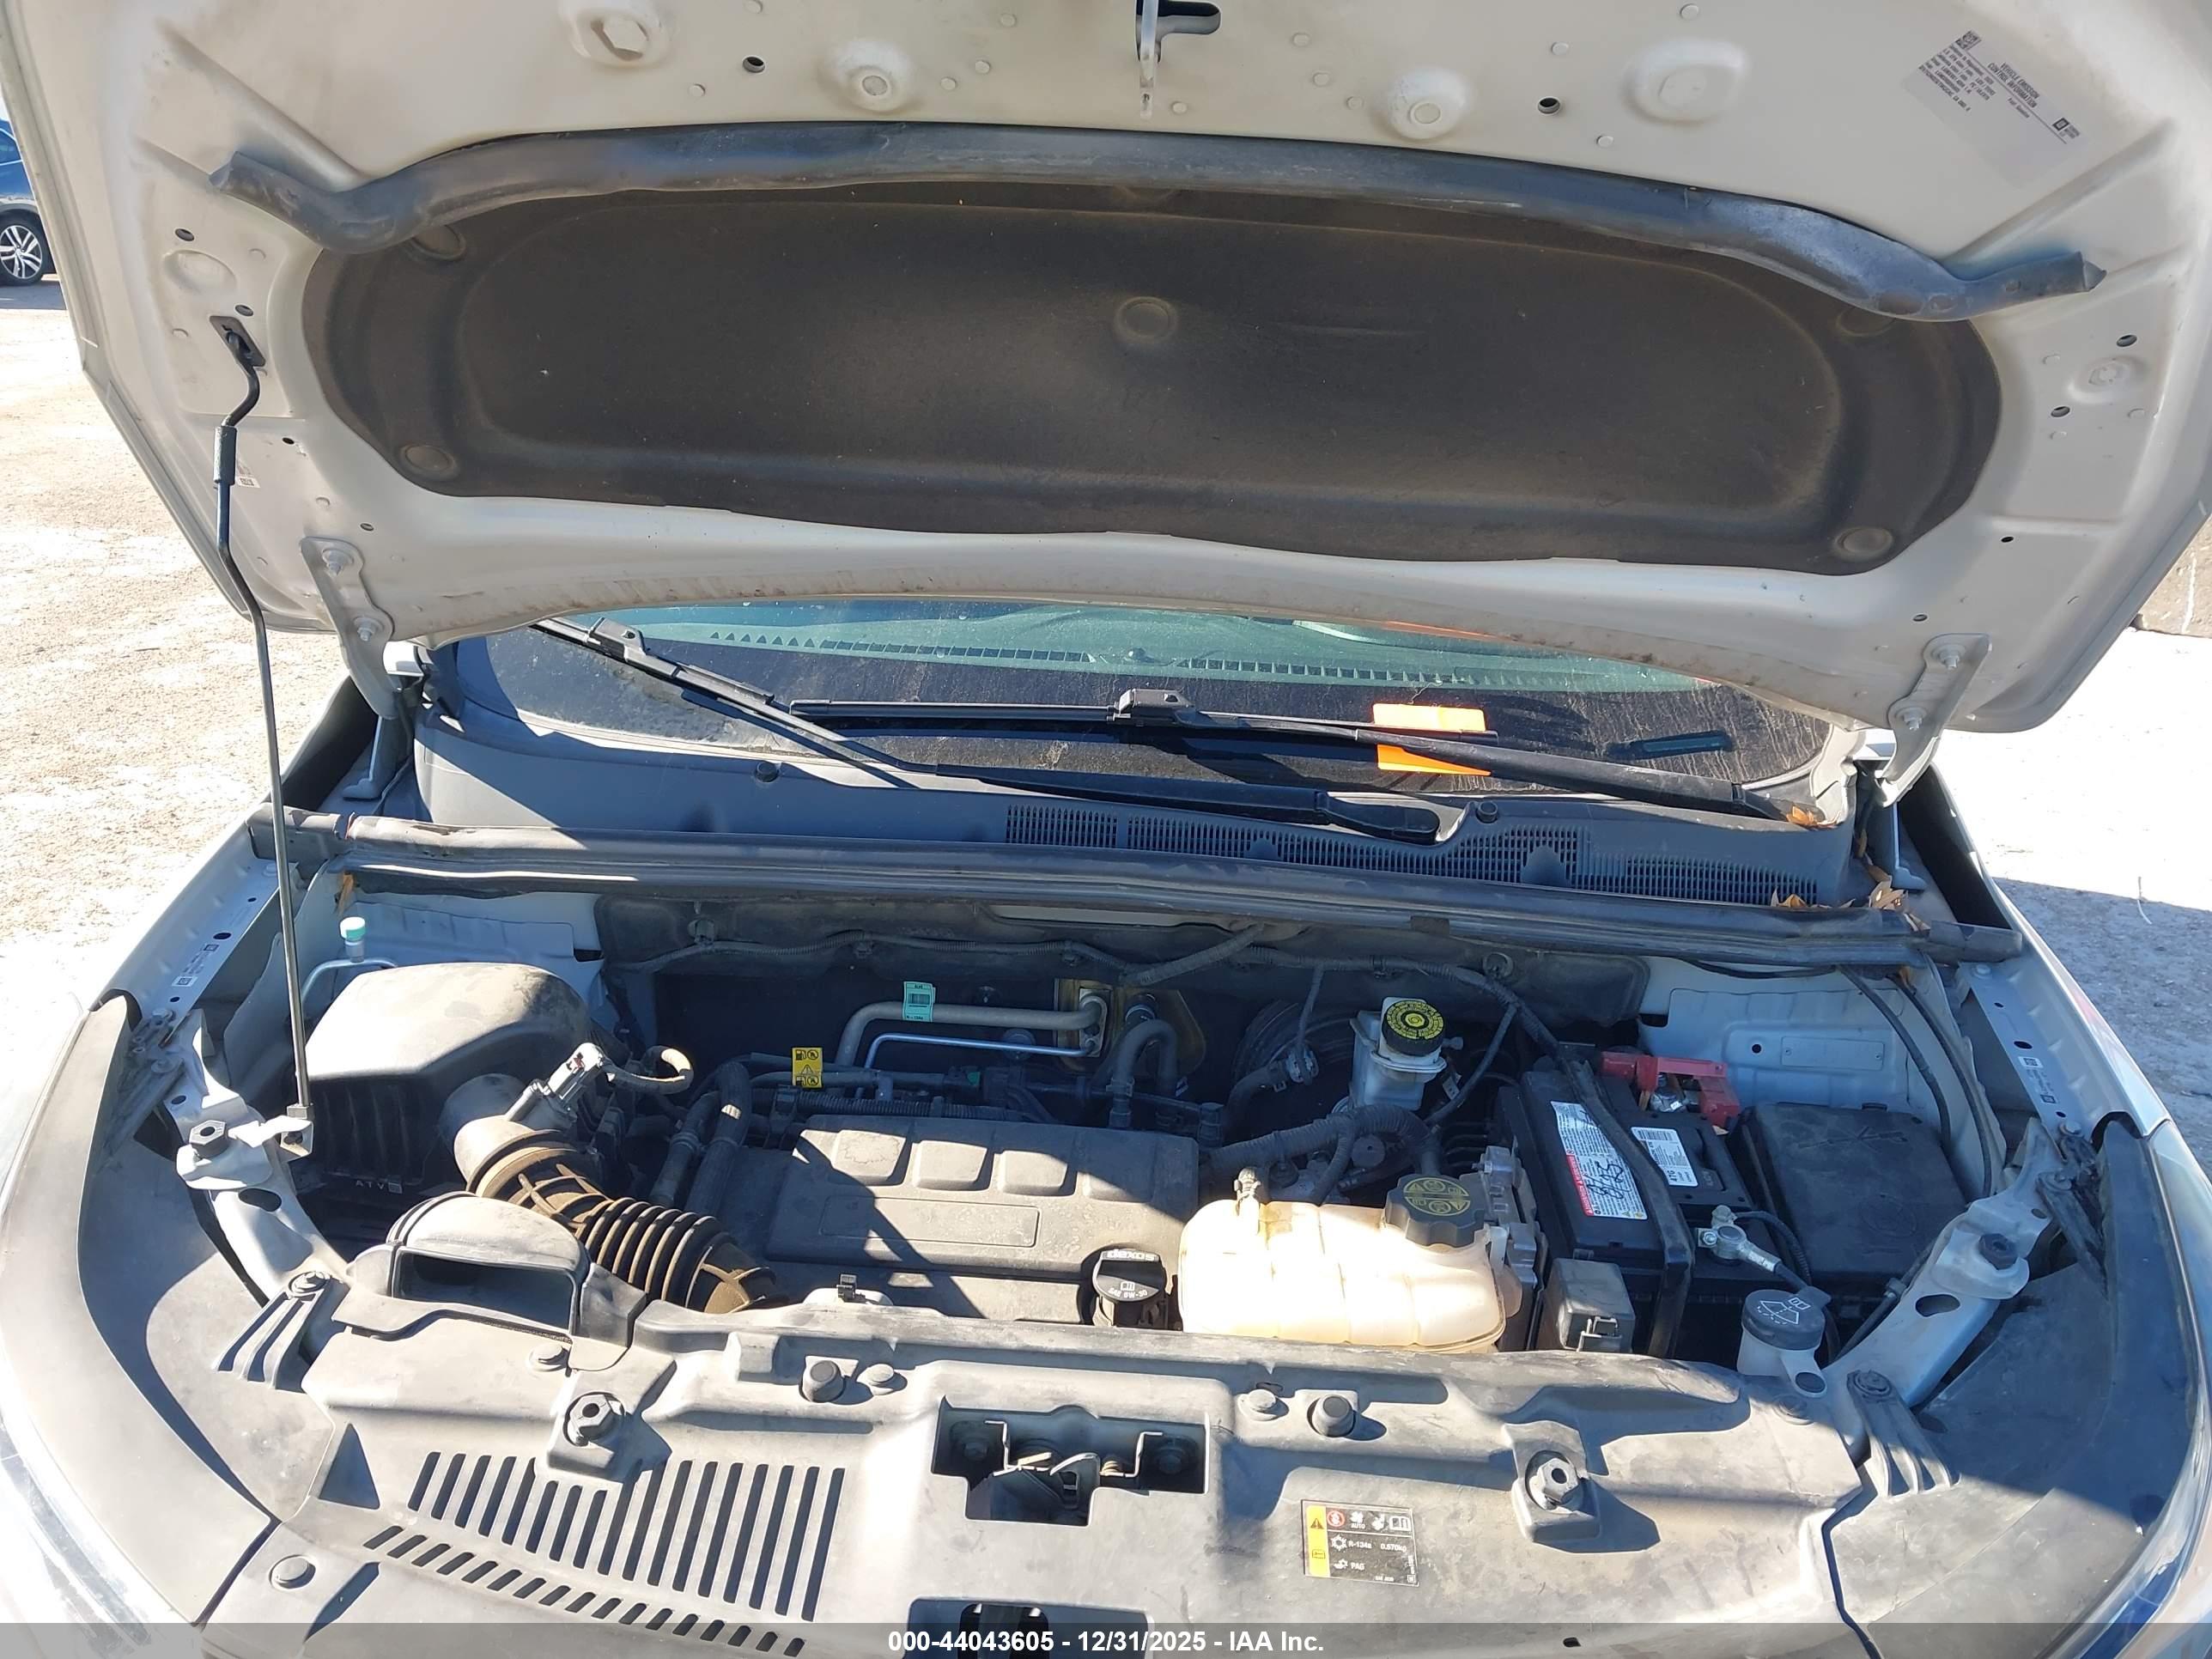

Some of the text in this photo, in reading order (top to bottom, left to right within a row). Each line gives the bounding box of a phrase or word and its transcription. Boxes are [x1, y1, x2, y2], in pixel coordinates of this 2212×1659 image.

[1987, 63, 2038, 108] CONTROL INFORMATION
[1108, 1249, 1155, 1261] dexos
[1348, 1540, 1372, 1549] R-134a
[1350, 1562, 1365, 1571] PAG
